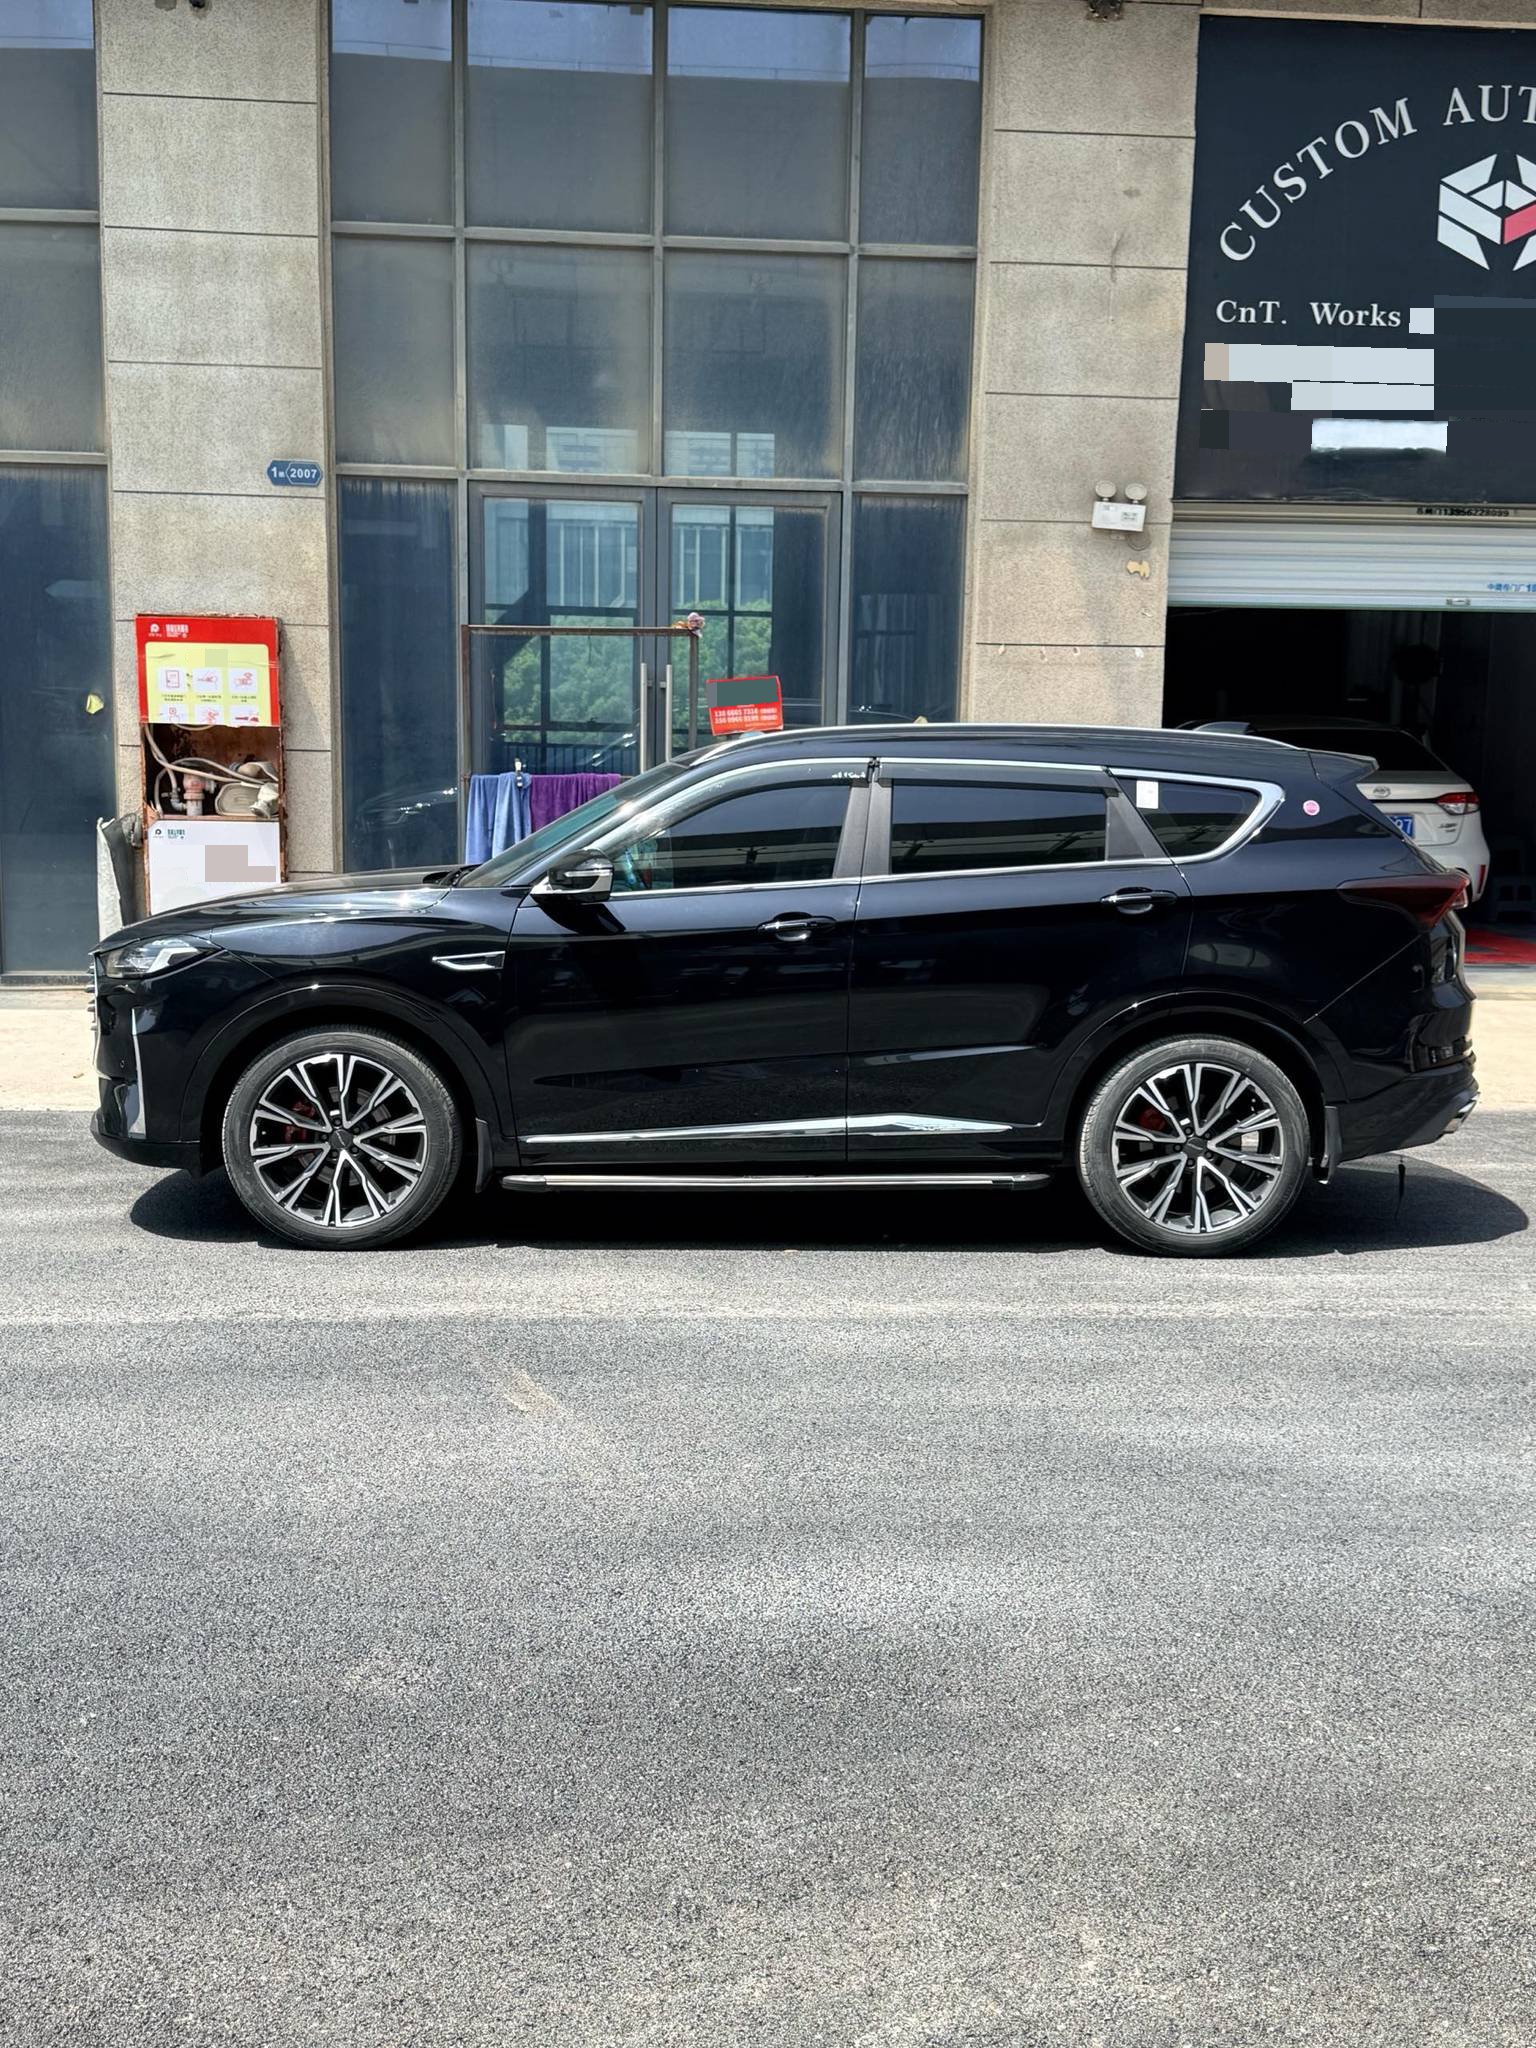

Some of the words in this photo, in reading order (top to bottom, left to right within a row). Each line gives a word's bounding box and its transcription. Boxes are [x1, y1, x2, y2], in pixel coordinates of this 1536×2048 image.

[1219, 97, 1418, 261] CUSTOM
[1442, 84, 1536, 126] AUT
[1215, 299, 1288, 325] CnT.
[1310, 302, 1402, 328] Works
[290, 468, 318, 479] 2007
